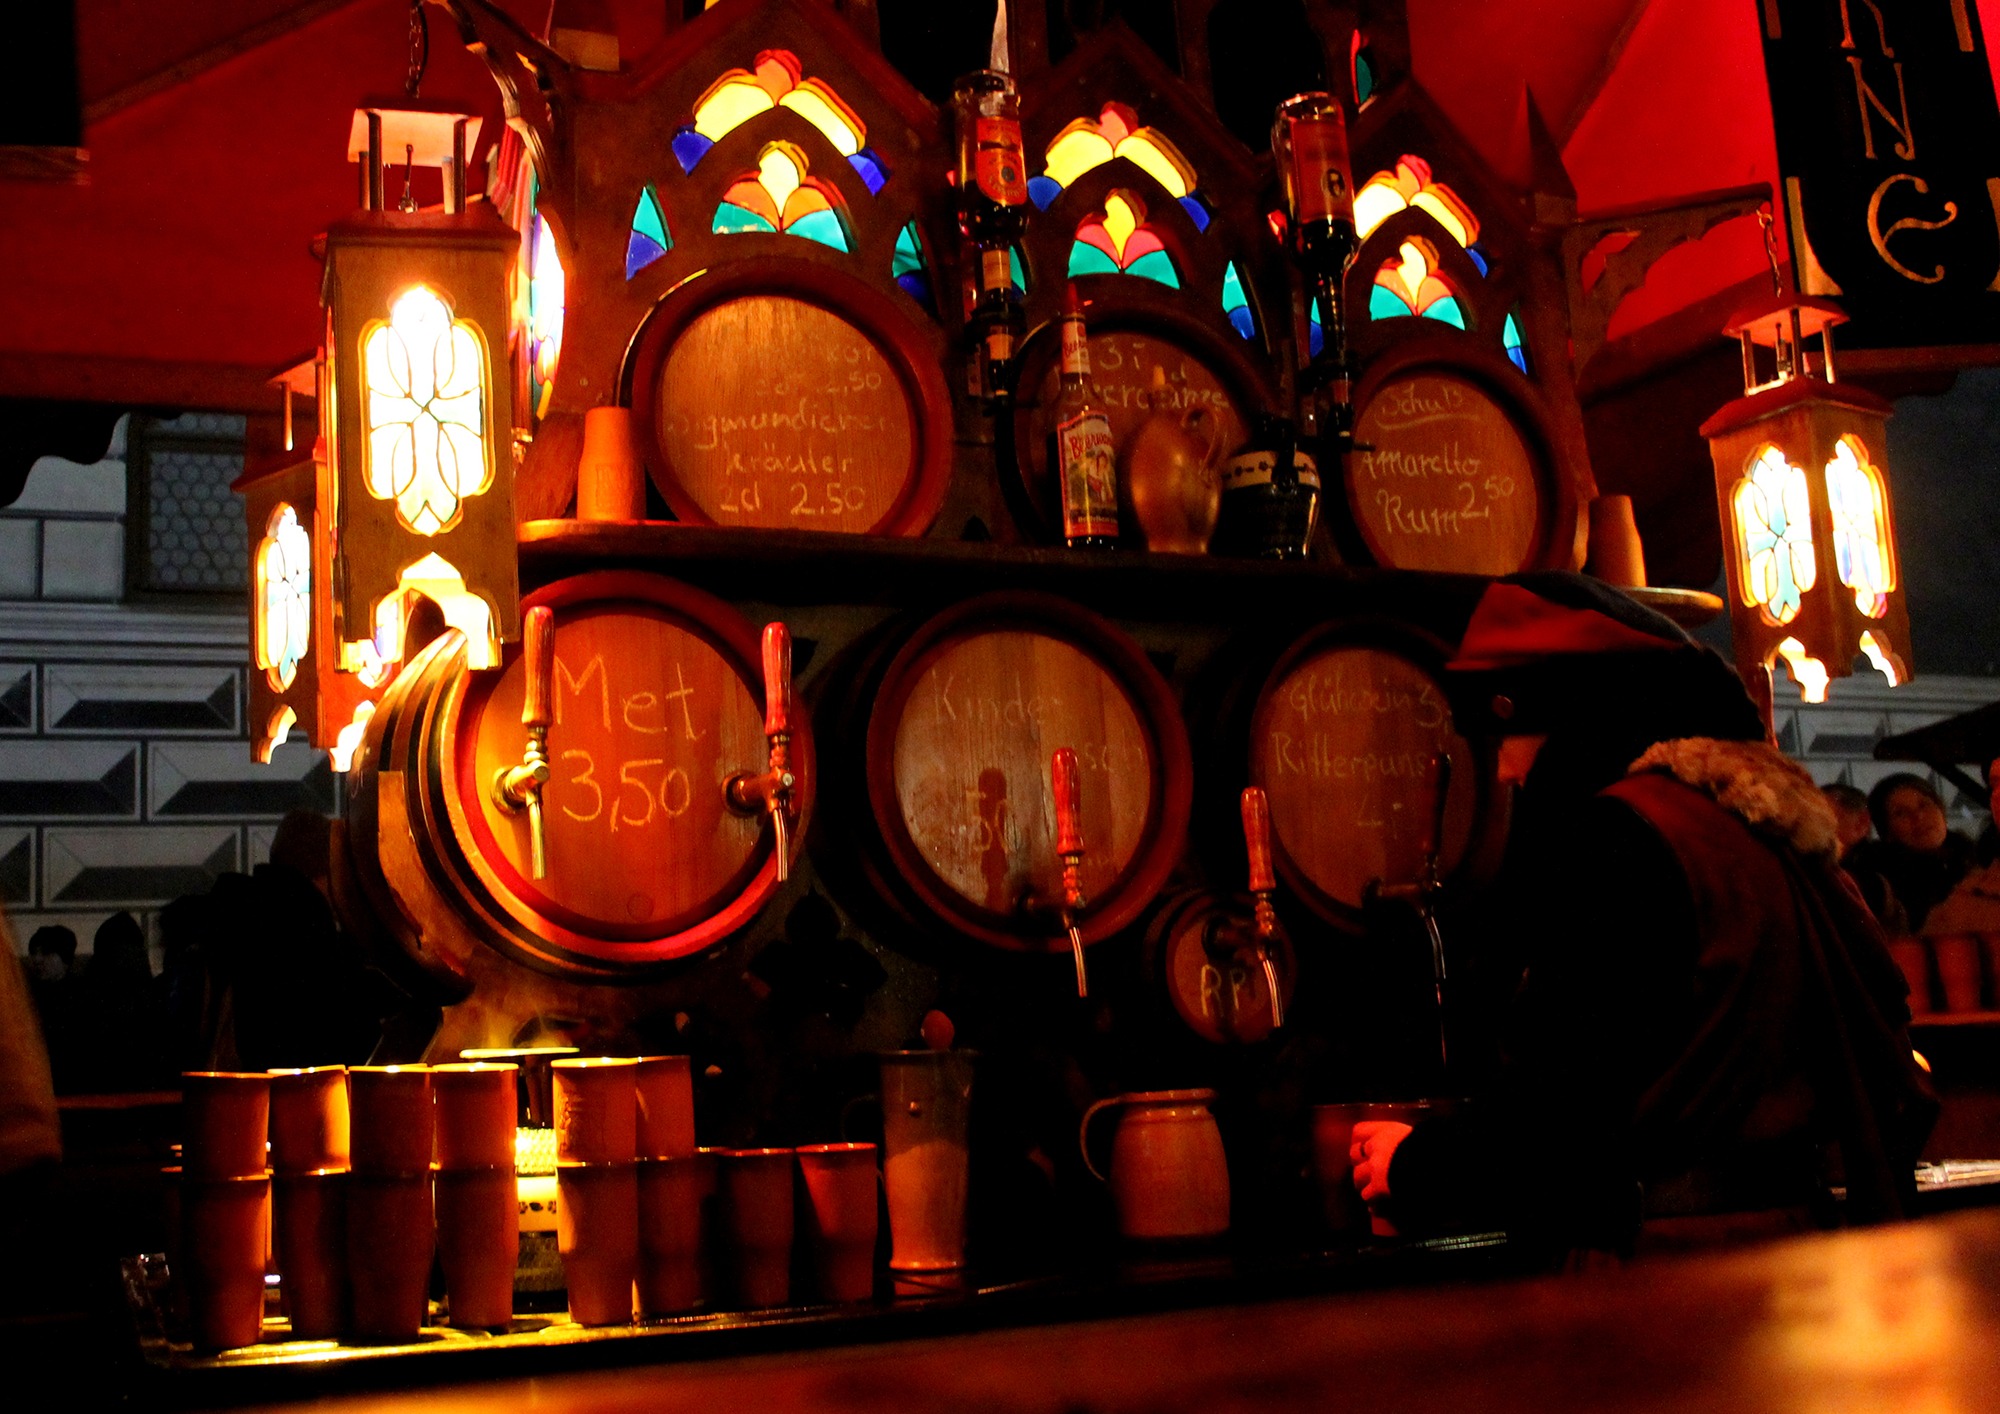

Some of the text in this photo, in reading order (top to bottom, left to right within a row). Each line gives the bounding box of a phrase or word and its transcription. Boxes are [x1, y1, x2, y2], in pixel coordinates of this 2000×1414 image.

[1375, 488, 1460, 536] Rum
[553, 653, 698, 741] Met
[562, 749, 690, 833] 3,50
